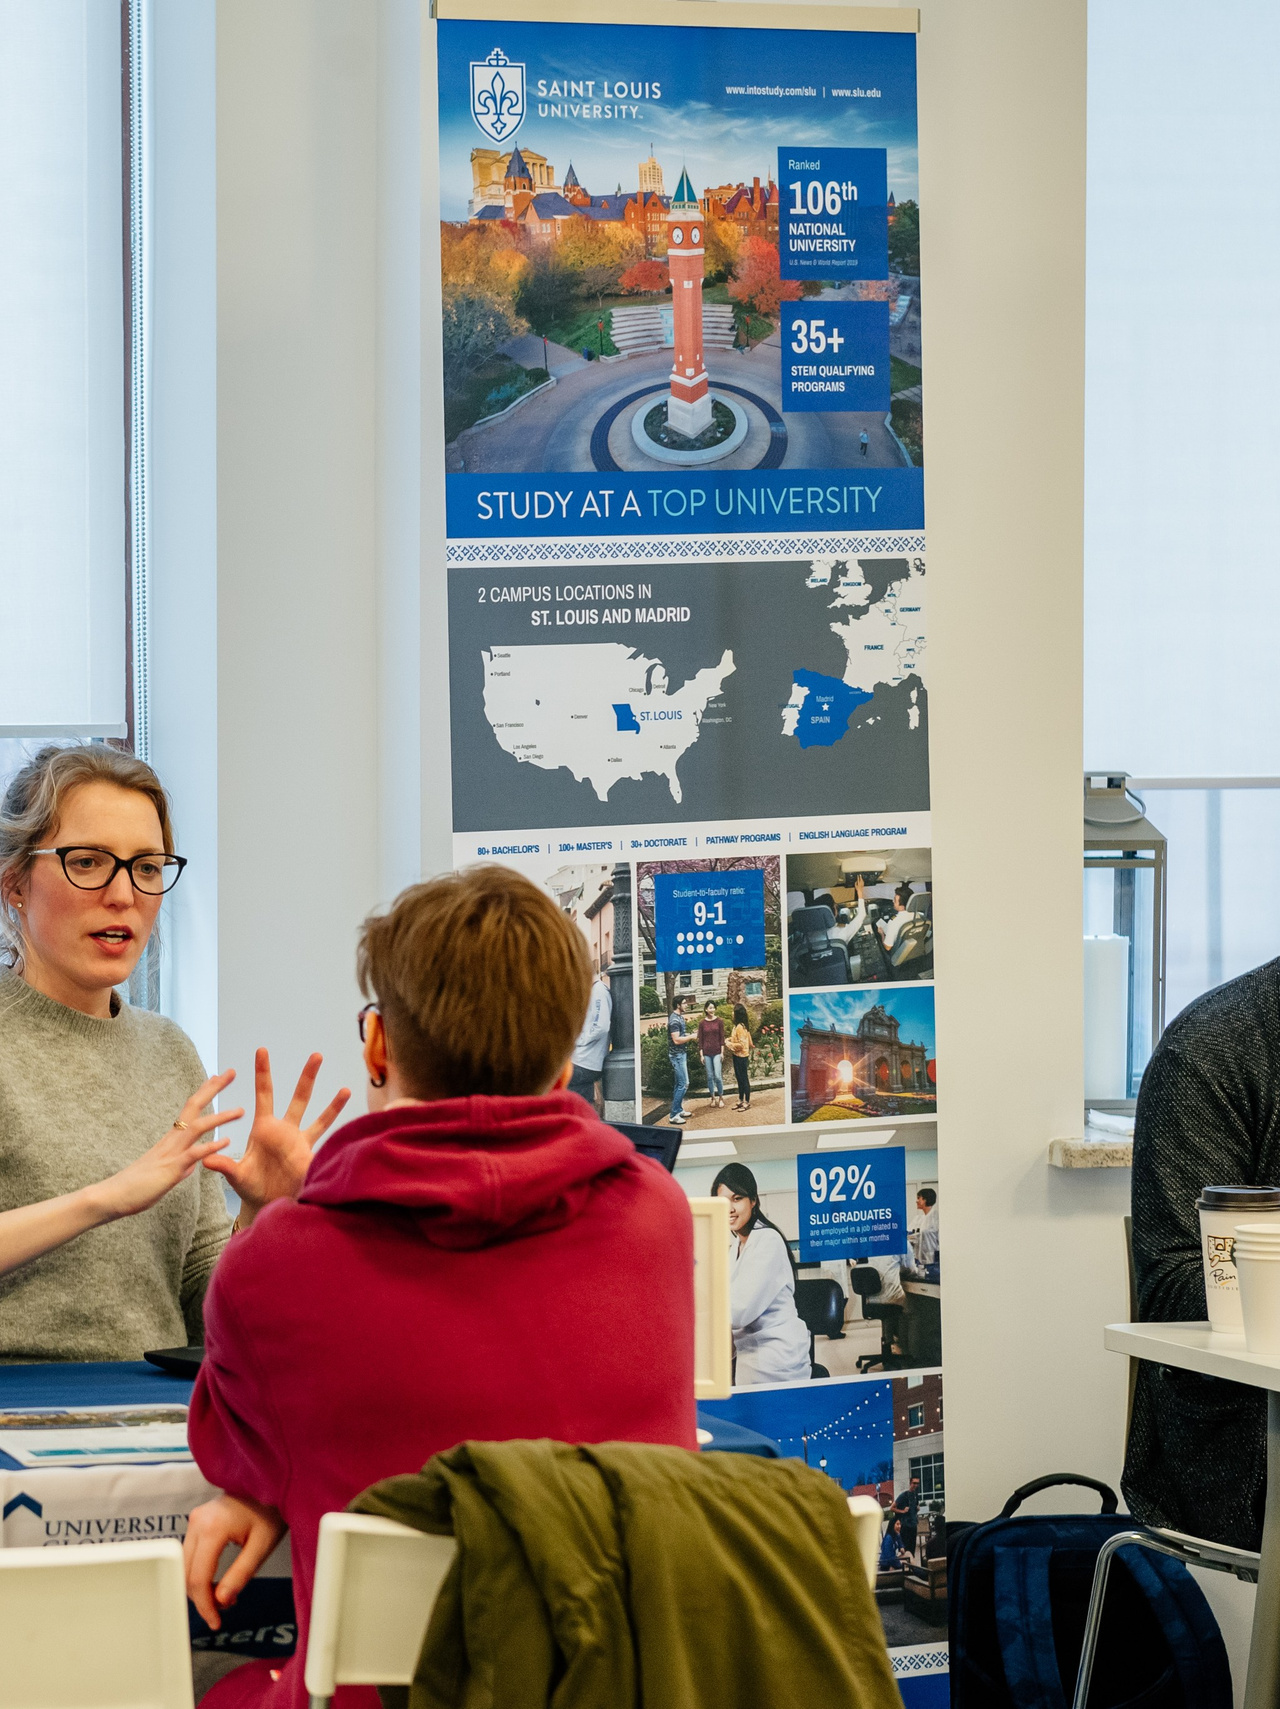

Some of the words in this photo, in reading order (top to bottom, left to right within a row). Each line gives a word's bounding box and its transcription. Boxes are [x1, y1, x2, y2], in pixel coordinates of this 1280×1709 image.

[537, 80, 595, 98] SAINT
[603, 81, 662, 100] LOUIS
[726, 84, 816, 98] www.intostudy.com/slu
[832, 88, 881, 98] www.slu.edu
[538, 105, 638, 118] UNIVERSITY
[788, 160, 820, 170] Ranked
[789, 181, 858, 215] 106th
[789, 223, 846, 236] NATIONAL
[790, 240, 856, 252] UNIVERSITY
[791, 319, 844, 354] 35+
[791, 366, 816, 376] STEM
[819, 365, 874, 377] QUALIFYING
[792, 382, 845, 392] PROGRAMS
[477, 492, 572, 520] STUDY
[580, 490, 614, 518] AT
[621, 490, 642, 517] A
[648, 489, 706, 517] TOP
[716, 486, 882, 515] UNIVERSITY
[478, 588, 486, 602] 2
[490, 586, 552, 602] CAMPUS
[556, 584, 634, 601] LOCATIONS
[638, 584, 652, 599] IN
[531, 610, 552, 626] ST.
[556, 608, 598, 625] LOUIS
[602, 608, 632, 623] AND
[634, 606, 690, 623] MADRID
[640, 711, 652, 721] ST.
[654, 711, 682, 720] LOUIS
[477, 846, 490, 856] 80+
[492, 844, 540, 854] BACHELOR'S
[558, 843, 574, 852] 100+
[576, 842, 612, 850] MASTER'S
[630, 839, 643, 848] 30+
[644, 837, 687, 847] DOCTORATE
[706, 835, 738, 844] PATHWAY
[740, 833, 780, 843] PROGRAMS
[799, 830, 828, 839] ENGLISH
[830, 828, 869, 838] LANGUAGE
[871, 826, 907, 836] PROGRAM
[673, 888, 728, 899] Student-to-faculty
[730, 888, 746, 896] ratio:
[694, 902, 726, 925] 9-1
[810, 1164, 876, 1204] 92%
[810, 1214, 829, 1225] SLU
[832, 1208, 892, 1224] GRADUATES
[821, 1225, 848, 1235] employed
[861, 1224, 870, 1232] job
[824, 1238, 840, 1247] major
[1210, 1269, 1236, 1284] Pain
